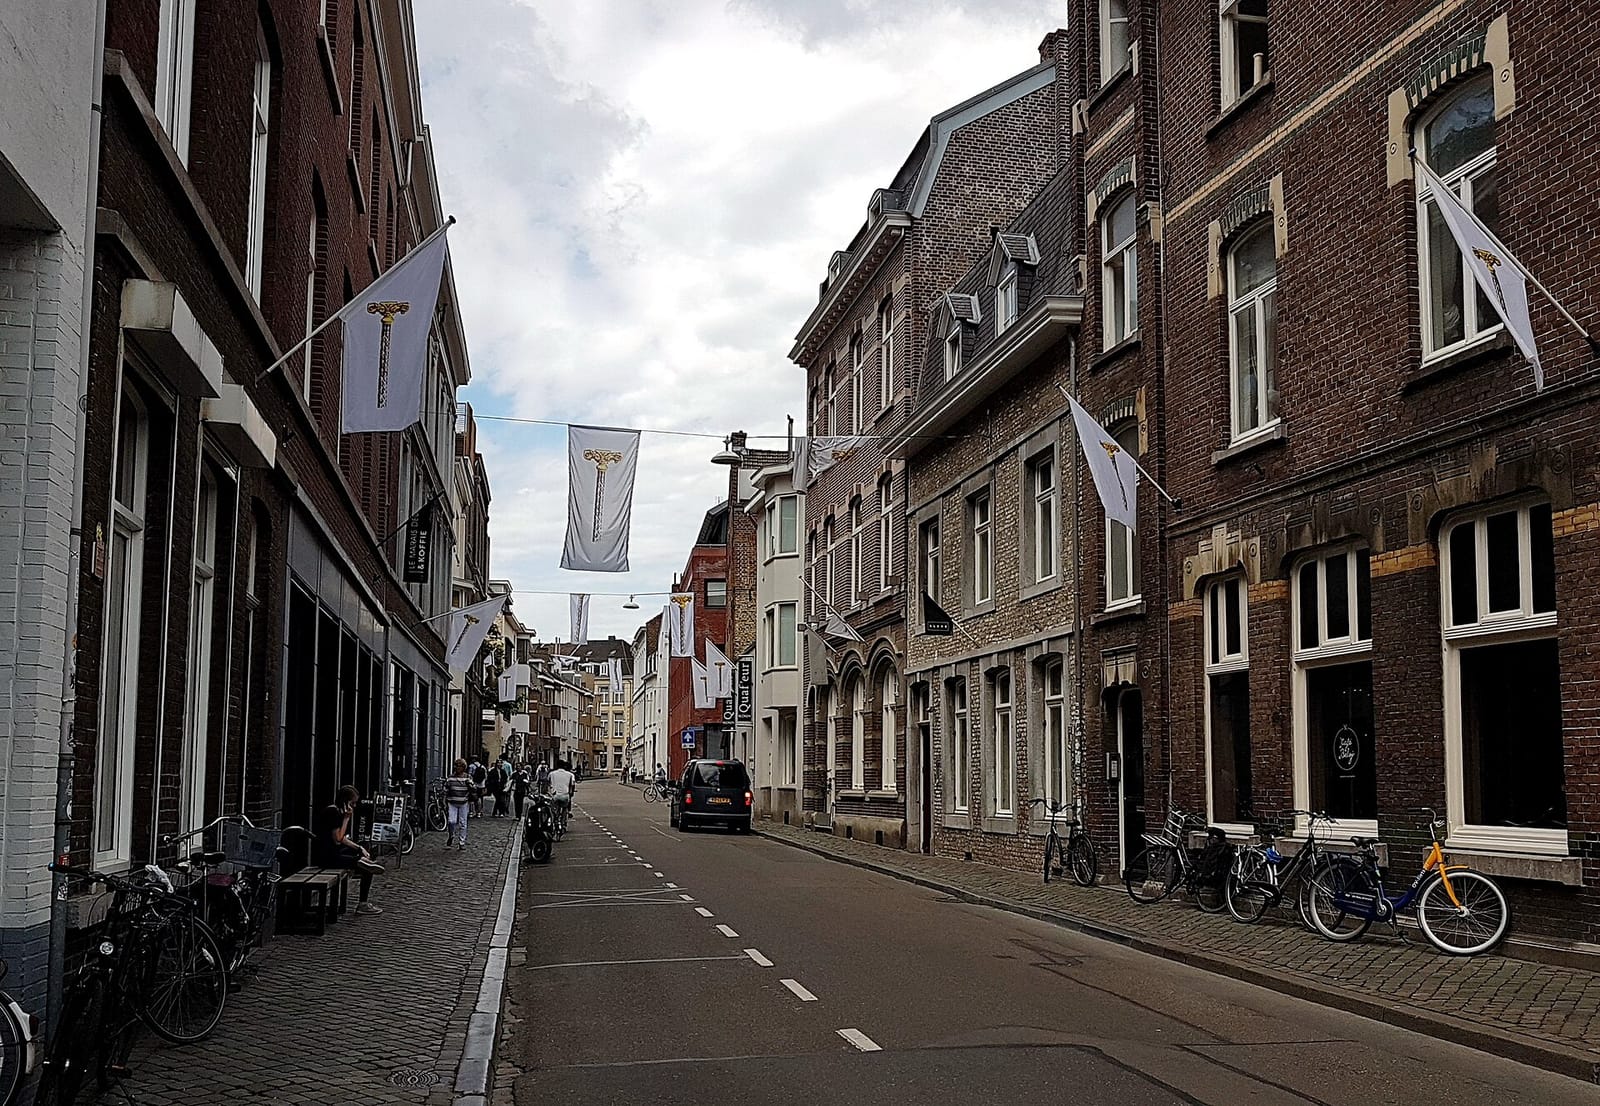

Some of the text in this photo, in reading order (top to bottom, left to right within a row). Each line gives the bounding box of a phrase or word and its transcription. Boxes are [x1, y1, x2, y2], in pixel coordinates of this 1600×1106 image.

[409, 530, 418, 558] MARAIS
[418, 530, 427, 562] KOFFIE
[408, 560, 416, 569] LE
